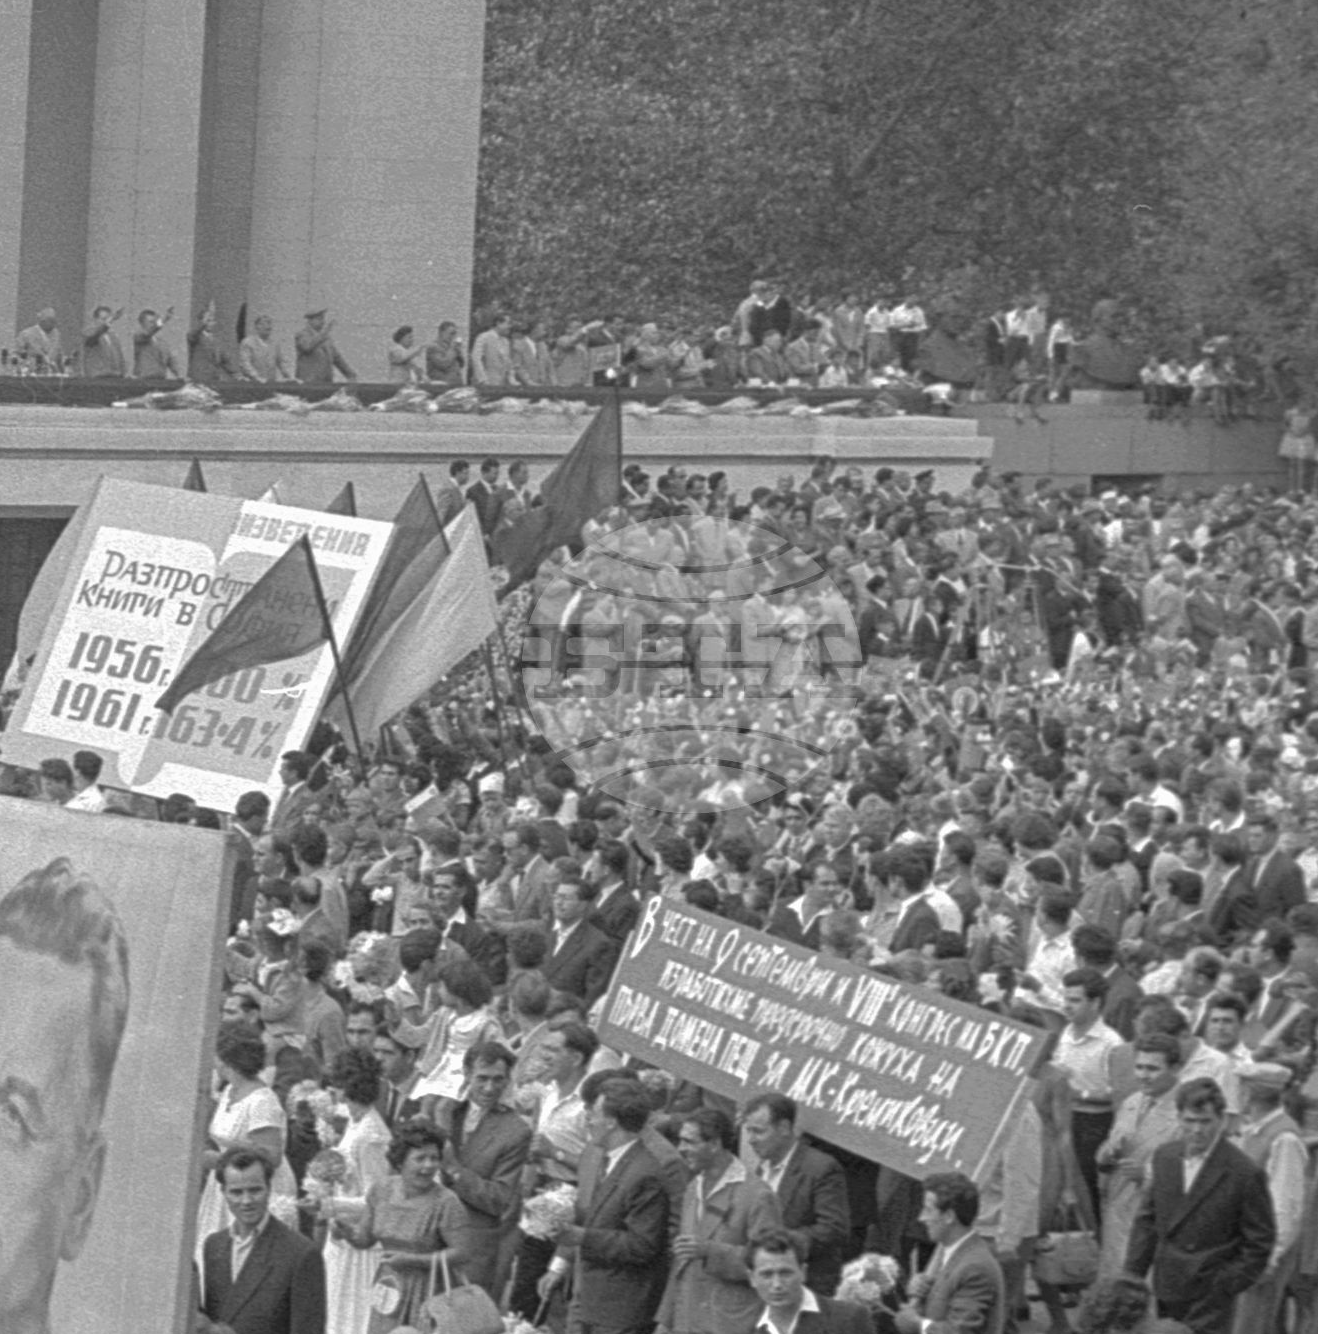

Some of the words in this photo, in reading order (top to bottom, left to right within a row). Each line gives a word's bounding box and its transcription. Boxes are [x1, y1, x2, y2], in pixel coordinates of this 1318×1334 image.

[630, 895, 663, 959] В
[660, 908, 698, 948] ЧЕСТ
[709, 927, 741, 975] 9
[607, 983, 661, 1040] ПЪРВА
[717, 1031, 763, 1087] ПЕЩ
[925, 1059, 965, 1100] НА
